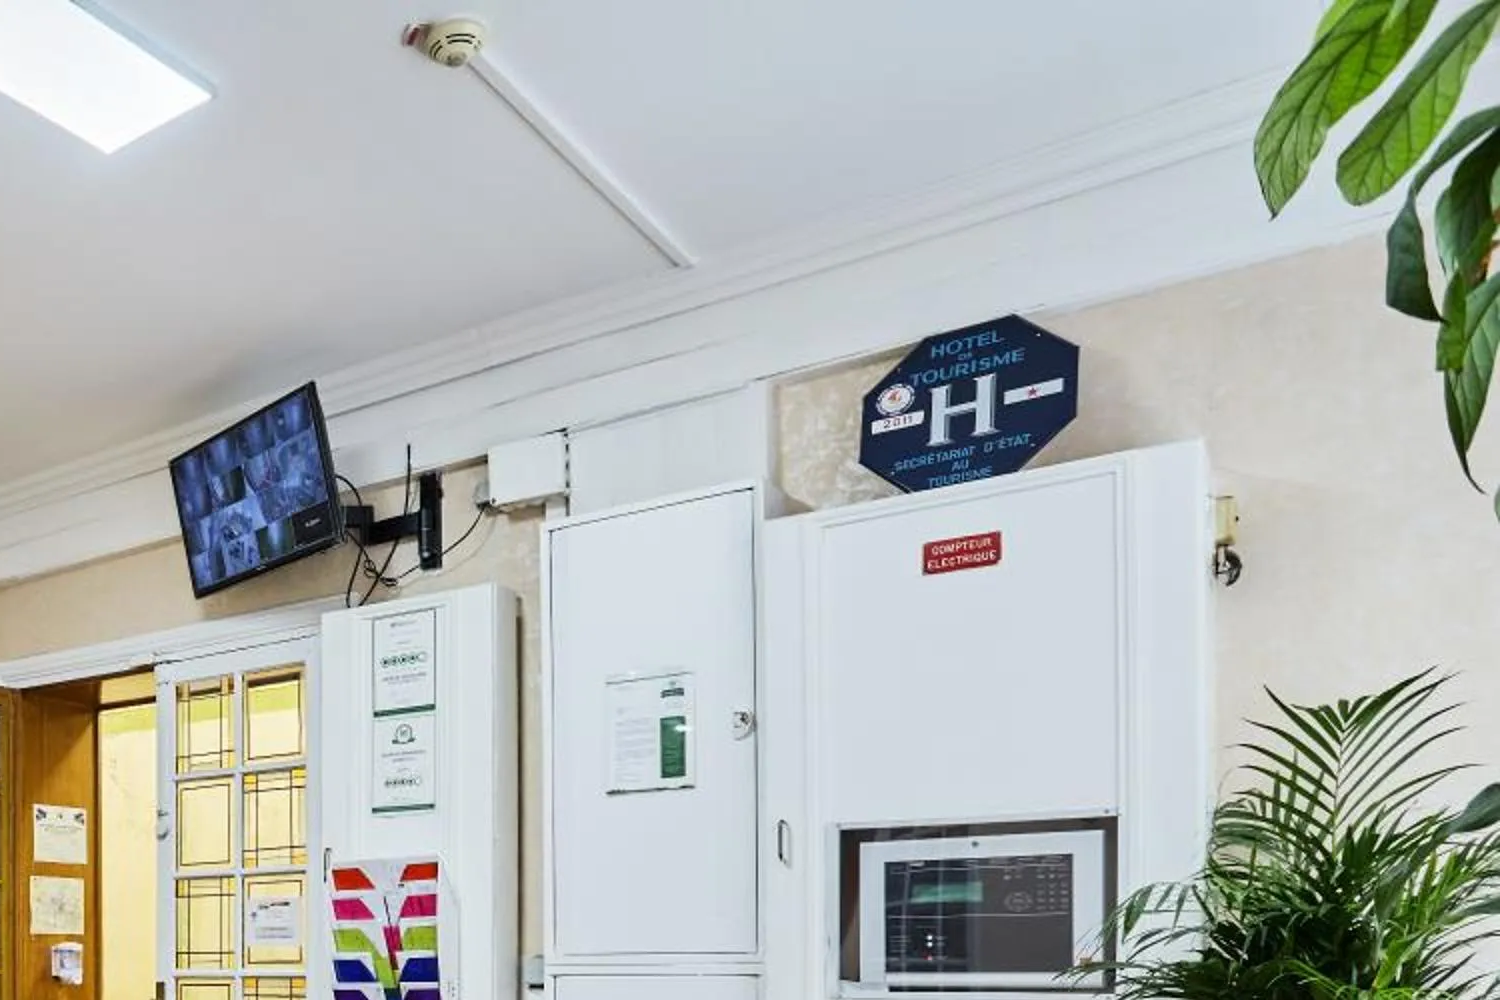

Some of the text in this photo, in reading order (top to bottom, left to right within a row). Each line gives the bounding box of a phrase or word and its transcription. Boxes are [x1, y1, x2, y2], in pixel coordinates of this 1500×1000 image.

[931, 329, 1004, 359] HOTEL
[909, 347, 1026, 386] TOURISME
[925, 372, 1000, 446] H
[883, 414, 913, 429] 2011
[951, 459, 970, 473] AU
[930, 537, 993, 556] COMPTEUR
[926, 550, 998, 570] ELECTRIQUE
